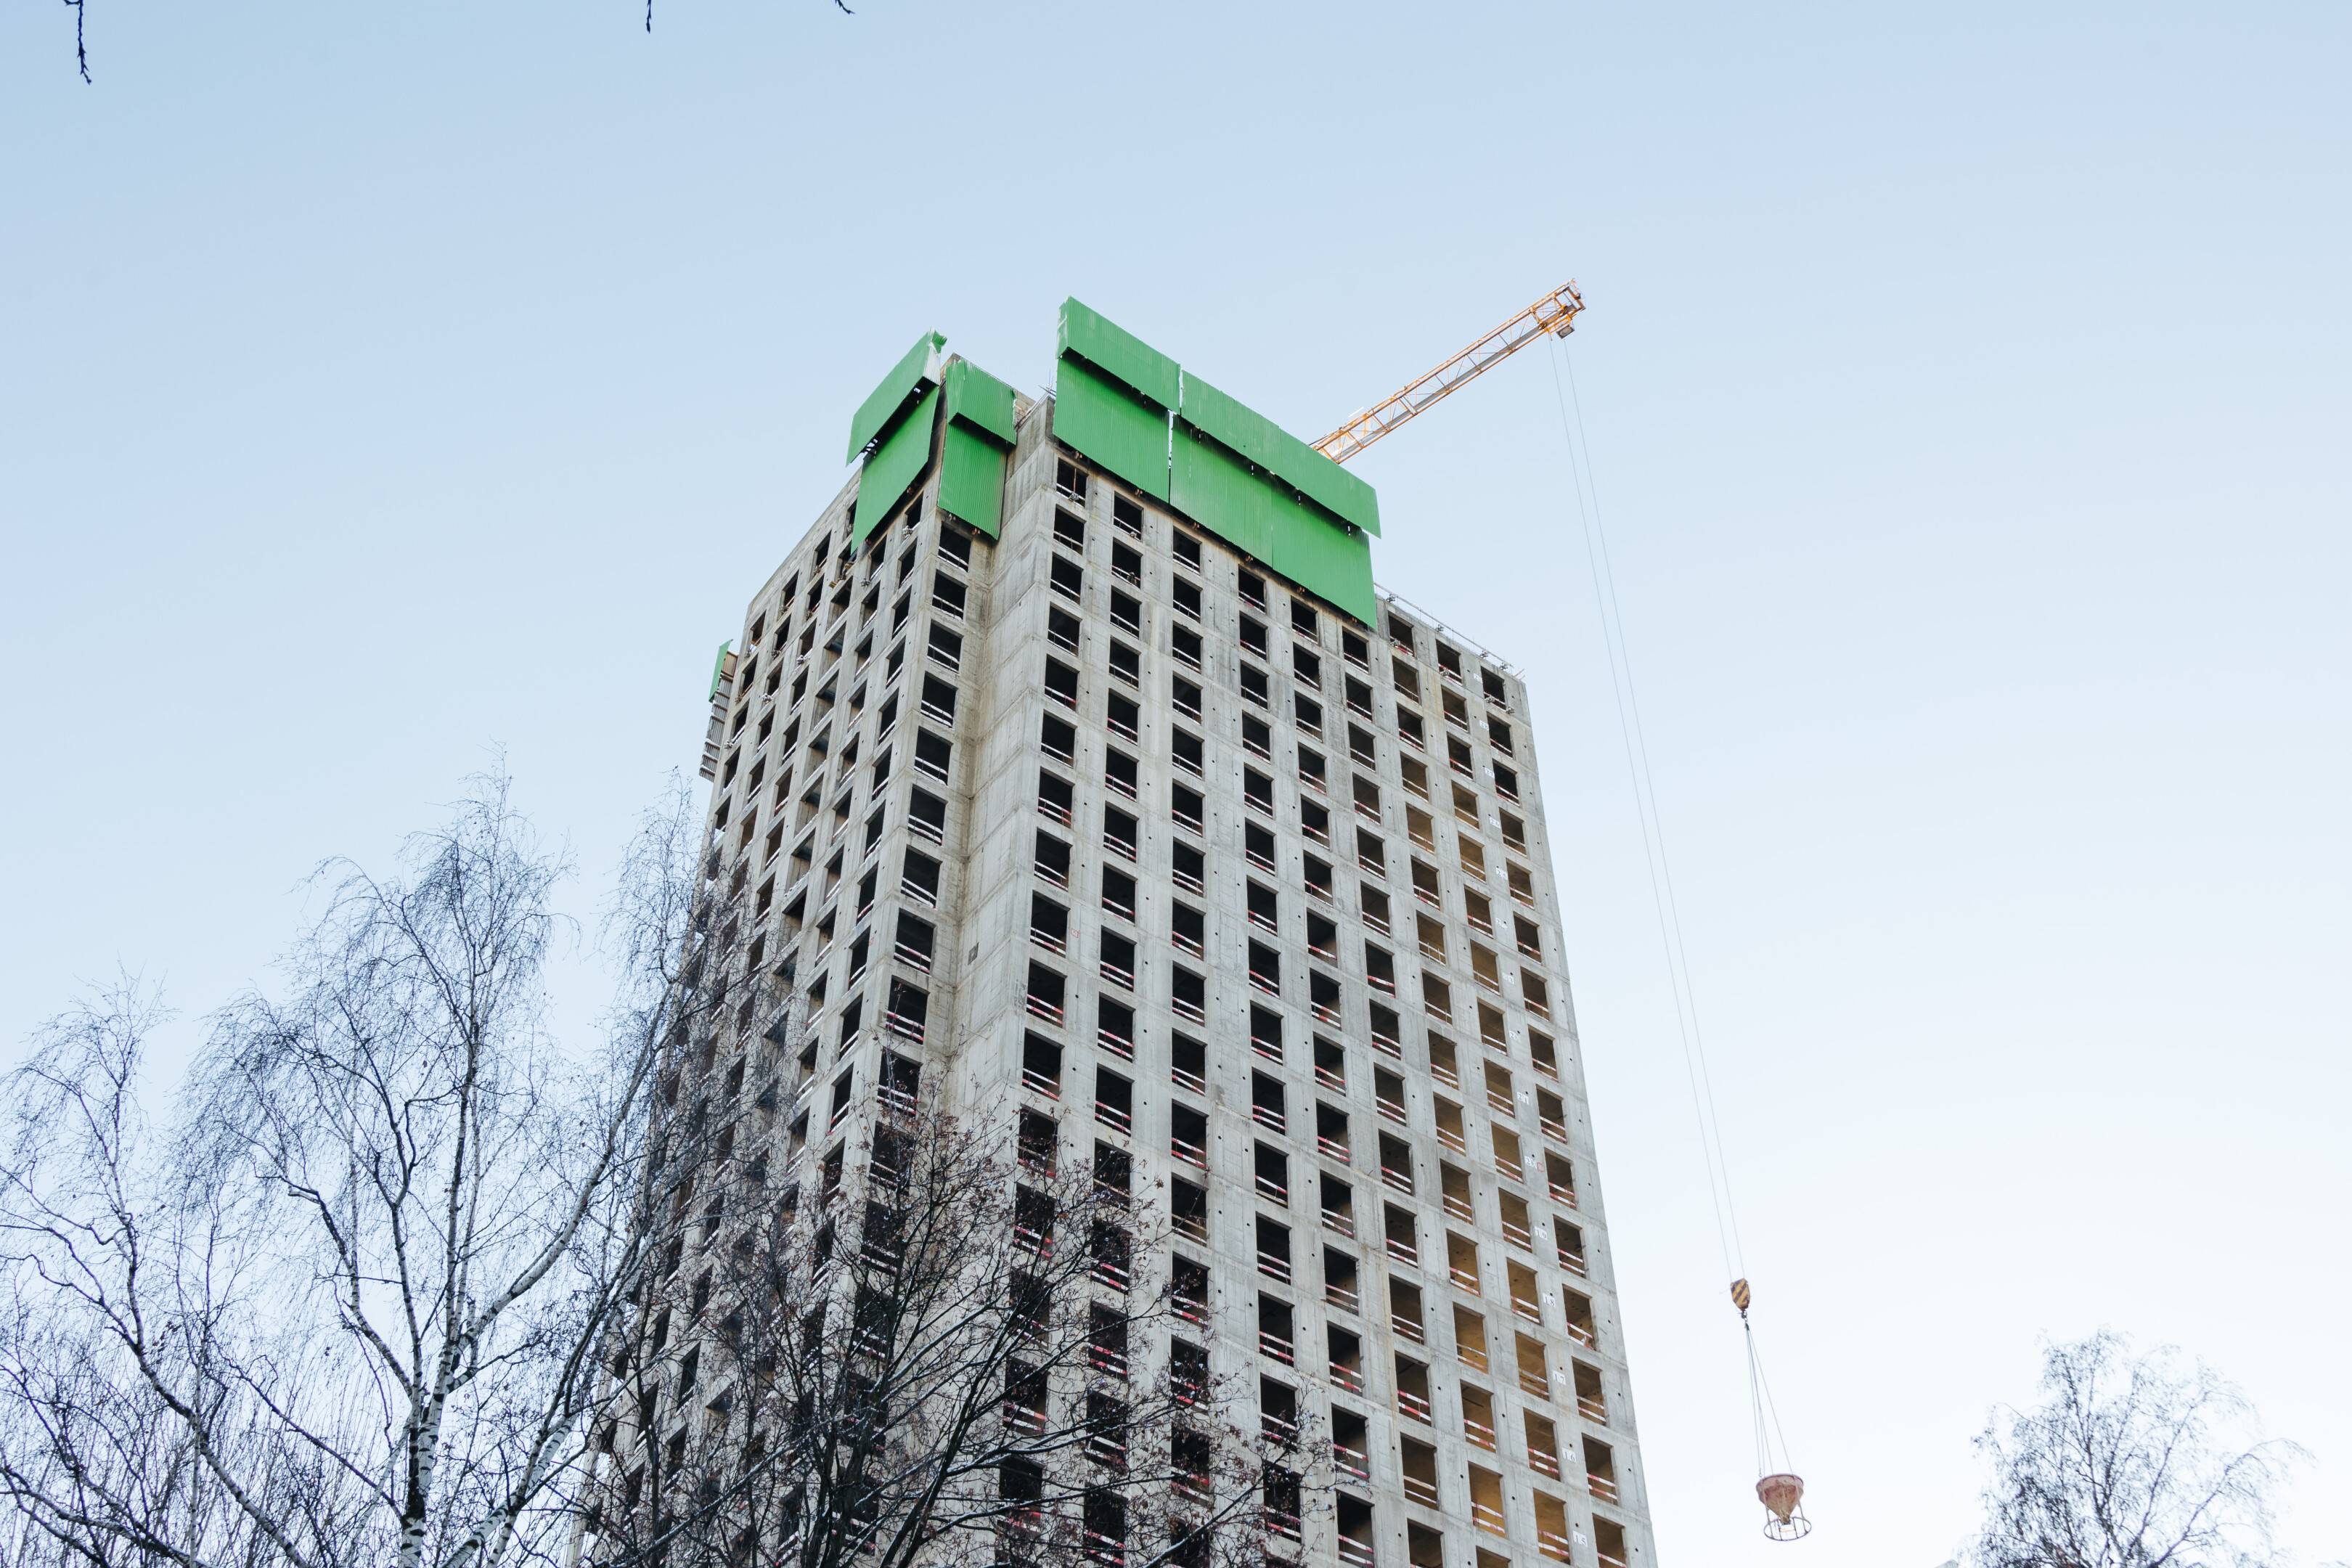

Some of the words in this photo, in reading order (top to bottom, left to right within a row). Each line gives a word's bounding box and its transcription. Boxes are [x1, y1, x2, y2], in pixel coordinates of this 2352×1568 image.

[1545, 1297, 1554, 1307] 18
[1555, 1373, 1564, 1383] 17
[1565, 1451, 1575, 1462] 16
[1576, 1535, 1586, 1545] 15
